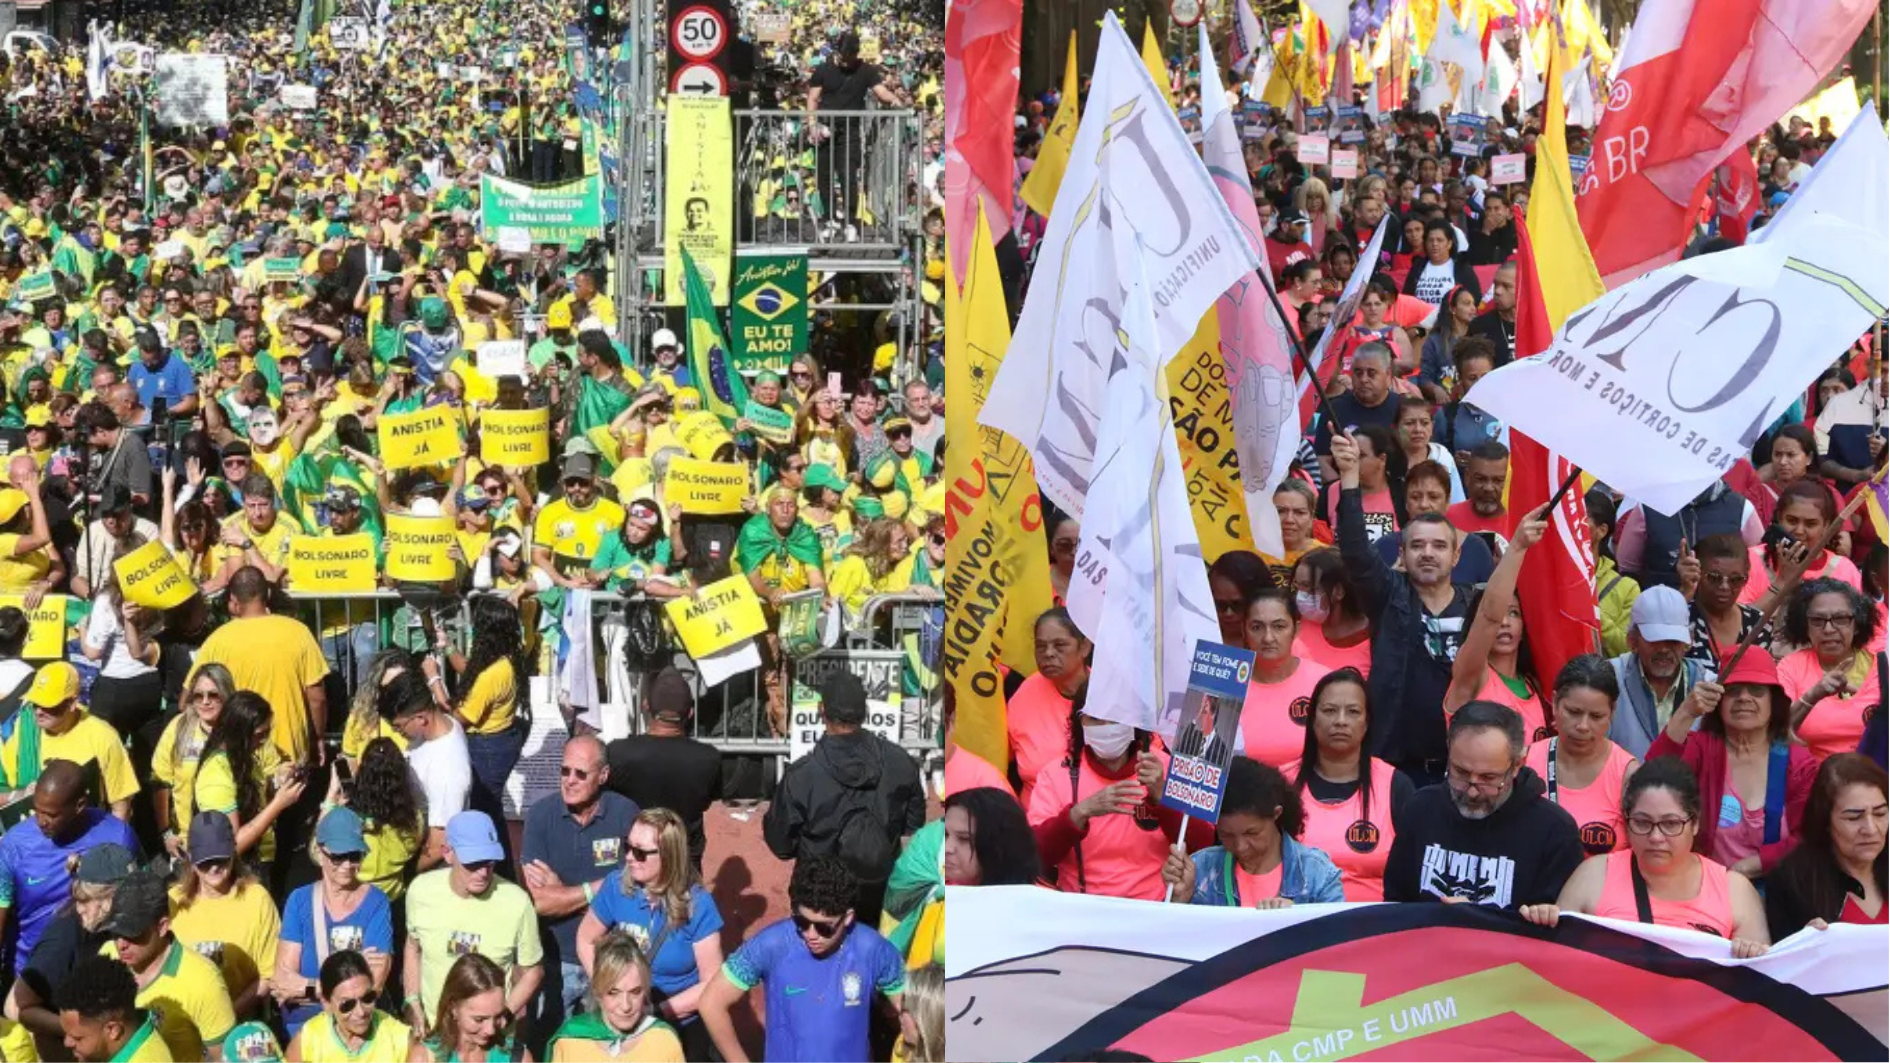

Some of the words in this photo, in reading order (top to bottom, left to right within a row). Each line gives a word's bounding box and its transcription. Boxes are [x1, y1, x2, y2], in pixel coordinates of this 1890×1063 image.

[683, 18, 717, 41] 50
[744, 326, 767, 339] EU
[771, 324, 794, 338] TE
[746, 339, 792, 353] AMO!
[1180, 367, 1217, 406] DE
[391, 415, 445, 438] ANISTIA
[484, 422, 547, 436] BOLSONARO
[1170, 396, 1219, 453] SÃO
[413, 440, 430, 456] JÁ
[503, 442, 533, 453] LIVRE
[670, 470, 743, 486] BOLSONARO
[690, 490, 722, 502] LIVRE
[294, 549, 369, 562] BOLSONARO
[400, 554, 433, 566] LIVRE
[315, 569, 348, 580] LIVRE
[1076, 550, 1108, 586] DAS
[685, 588, 741, 621] ANISTIA
[715, 618, 733, 637] JÁ
[1196, 650, 1212, 662] VOCÊ
[1222, 656, 1239, 669] FOME
[796, 660, 900, 687] PREDENTE
[1291, 704, 1311, 718] ULC
[1171, 754, 1206, 783] PRISÃO
[1203, 764, 1223, 790] DE
[1165, 778, 1218, 813] BOLSONARO!
[1349, 828, 1377, 843] ULCM
[1292, 1028, 1354, 1062] CMP
[1363, 1018, 1383, 1043] E
[1389, 996, 1459, 1034] UMM
